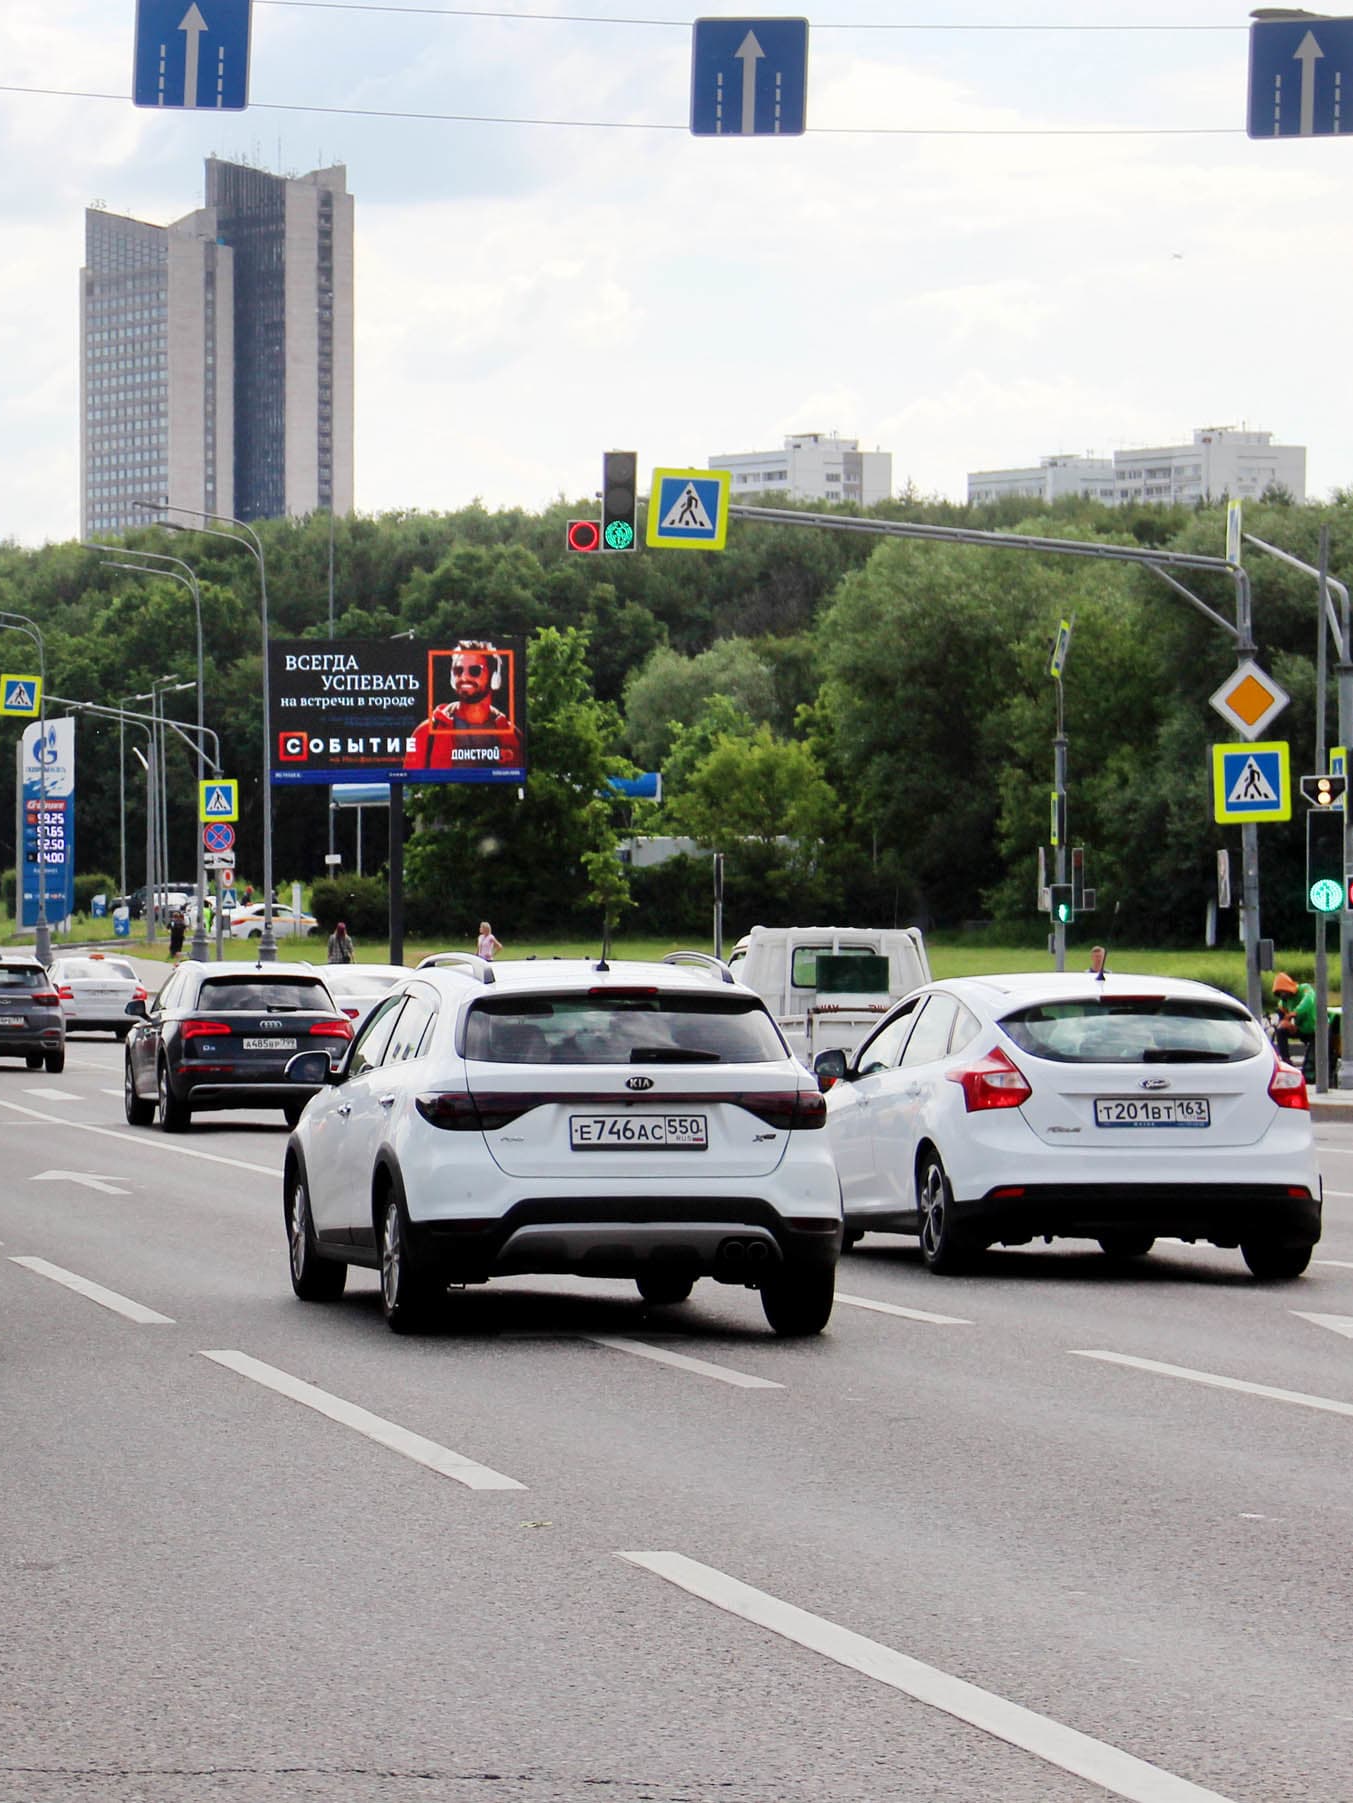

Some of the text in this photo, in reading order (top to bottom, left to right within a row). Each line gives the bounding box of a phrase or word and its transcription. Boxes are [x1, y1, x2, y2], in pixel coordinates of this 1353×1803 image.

[285, 654, 359, 673] ВСЕГДА
[321, 674, 420, 691] УСПЕВАТЬ
[280, 696, 415, 709] на встречи в городе
[286, 737, 417, 754] СОБЫТИЕ
[451, 746, 500, 761] ДОНСТРОЙ
[629, 1078, 651, 1088] KIA
[1177, 1101, 1204, 1115] 163
[667, 1119, 700, 1134] 550
